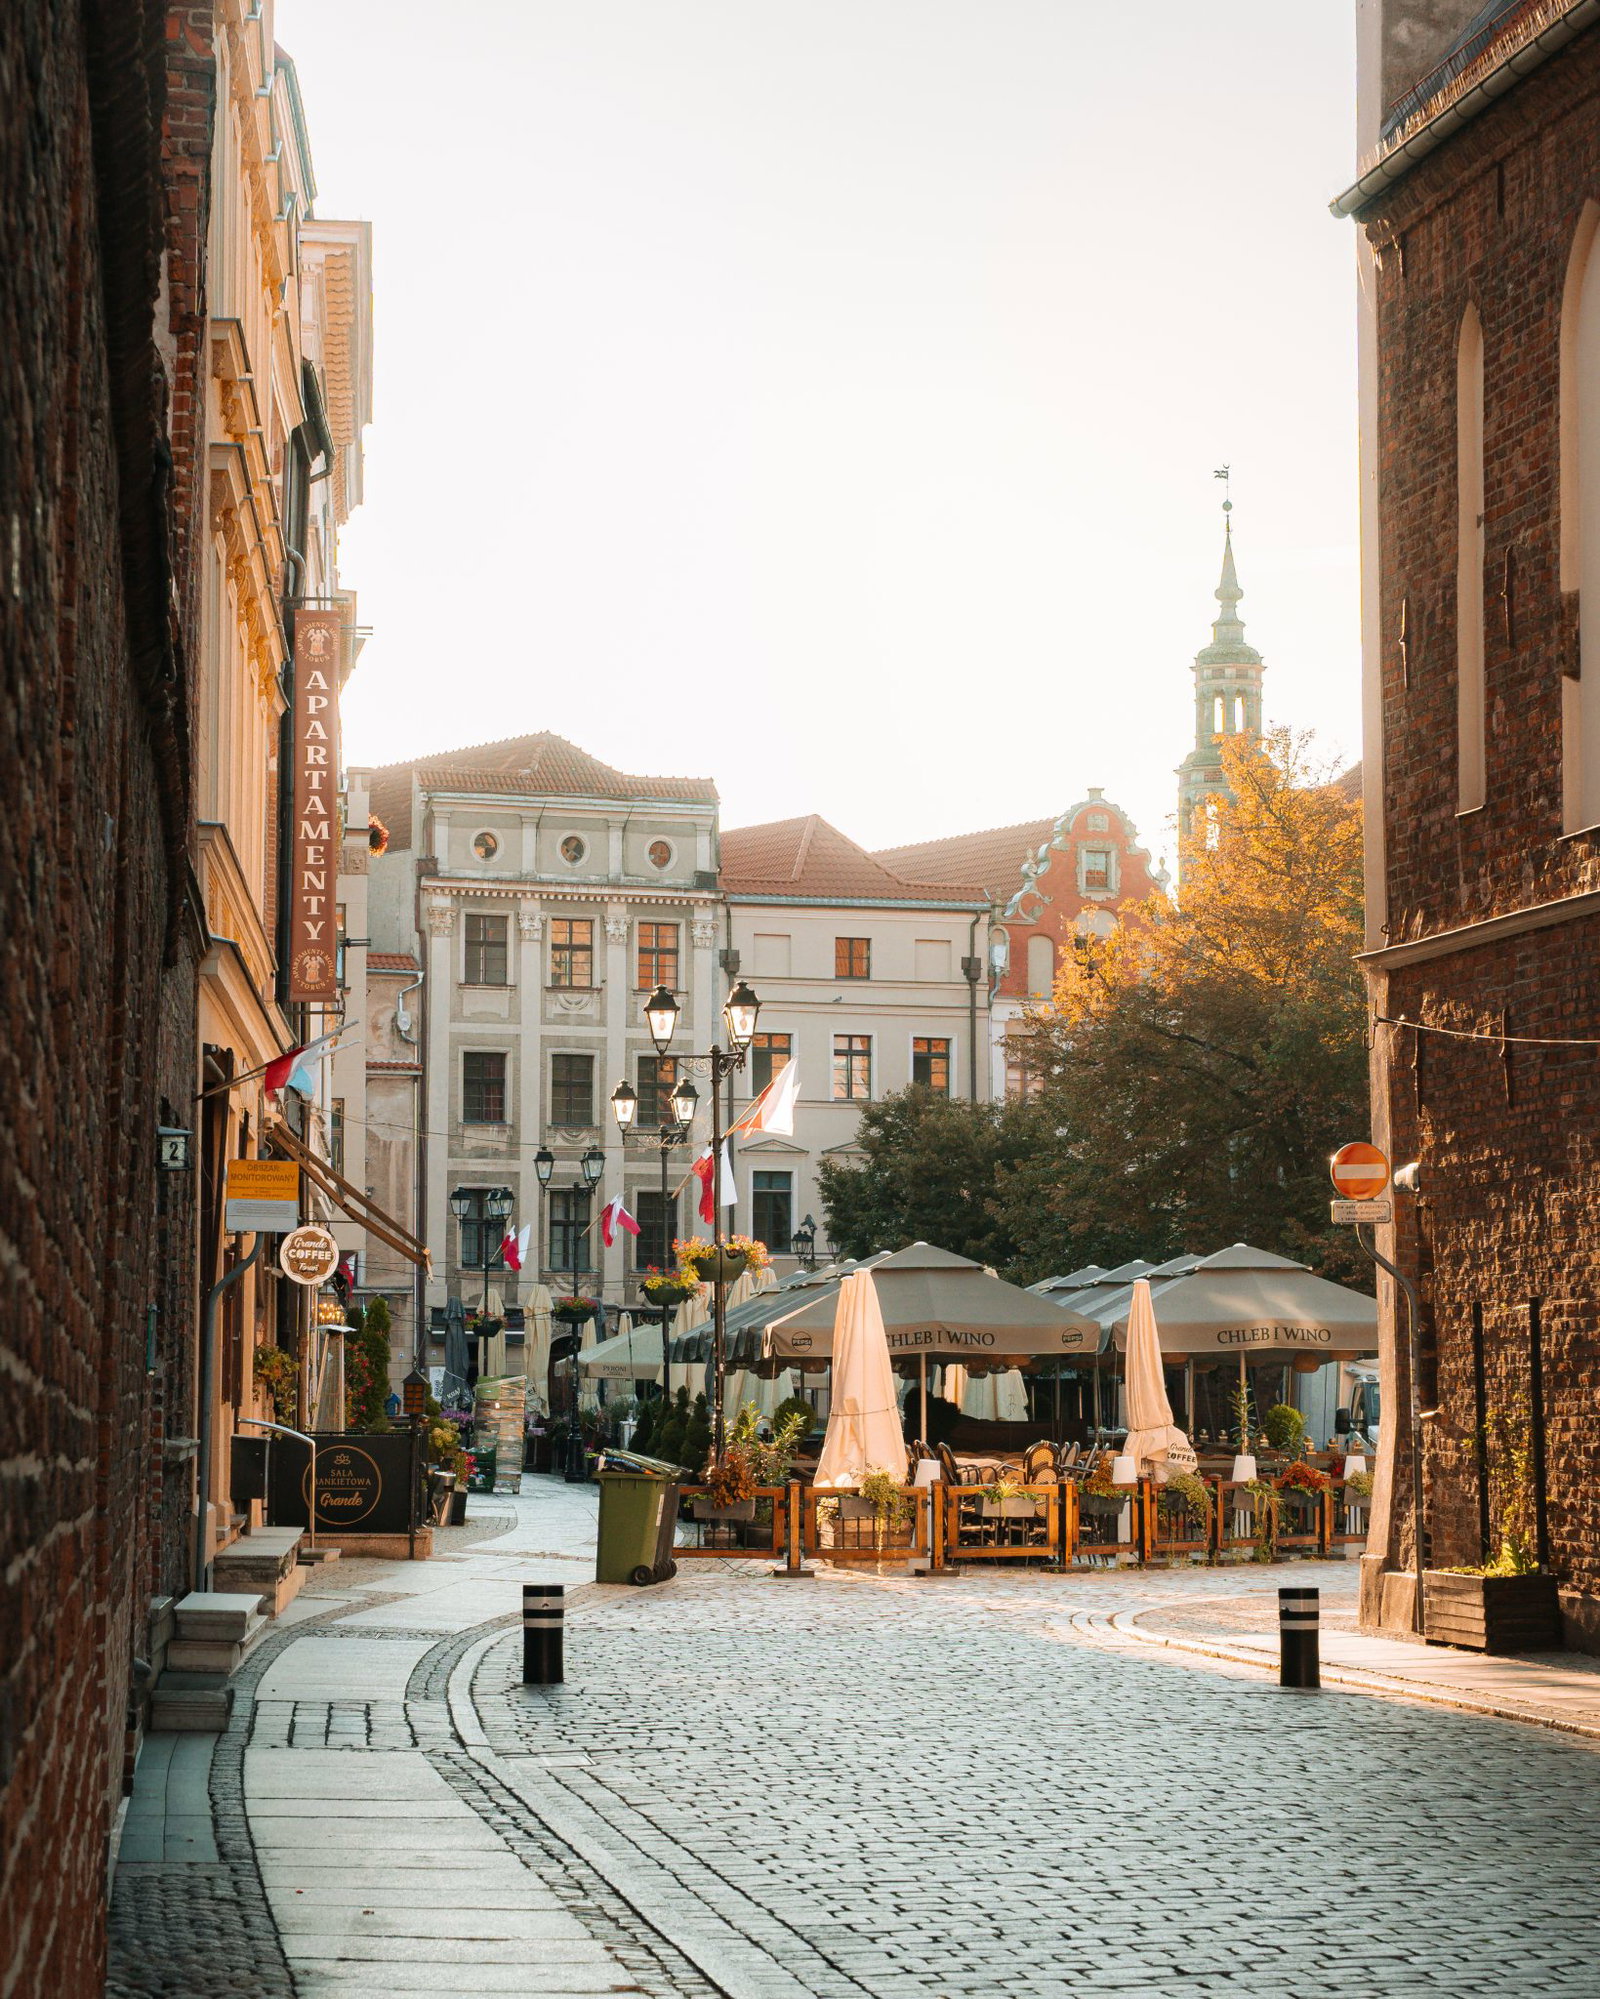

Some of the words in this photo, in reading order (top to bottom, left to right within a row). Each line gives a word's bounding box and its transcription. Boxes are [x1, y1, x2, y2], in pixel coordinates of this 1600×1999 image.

[299, 670, 331, 940] APARTAMENTY
[169, 1141, 179, 1160] 2
[231, 1173, 295, 1183] MONITOROWANY
[294, 1236, 328, 1249] Grande
[288, 1248, 332, 1260] COFFEE
[937, 1330, 942, 1344] I
[946, 1331, 995, 1346] WINO
[1216, 1327, 1270, 1344] CHLEB
[1273, 1327, 1279, 1340] I
[1282, 1327, 1331, 1343] WINO
[1167, 1452, 1196, 1463] COFFEE
[330, 1469, 353, 1477] SALA
[315, 1478, 372, 1486] ANKIETOWA
[320, 1491, 364, 1507] Grande
